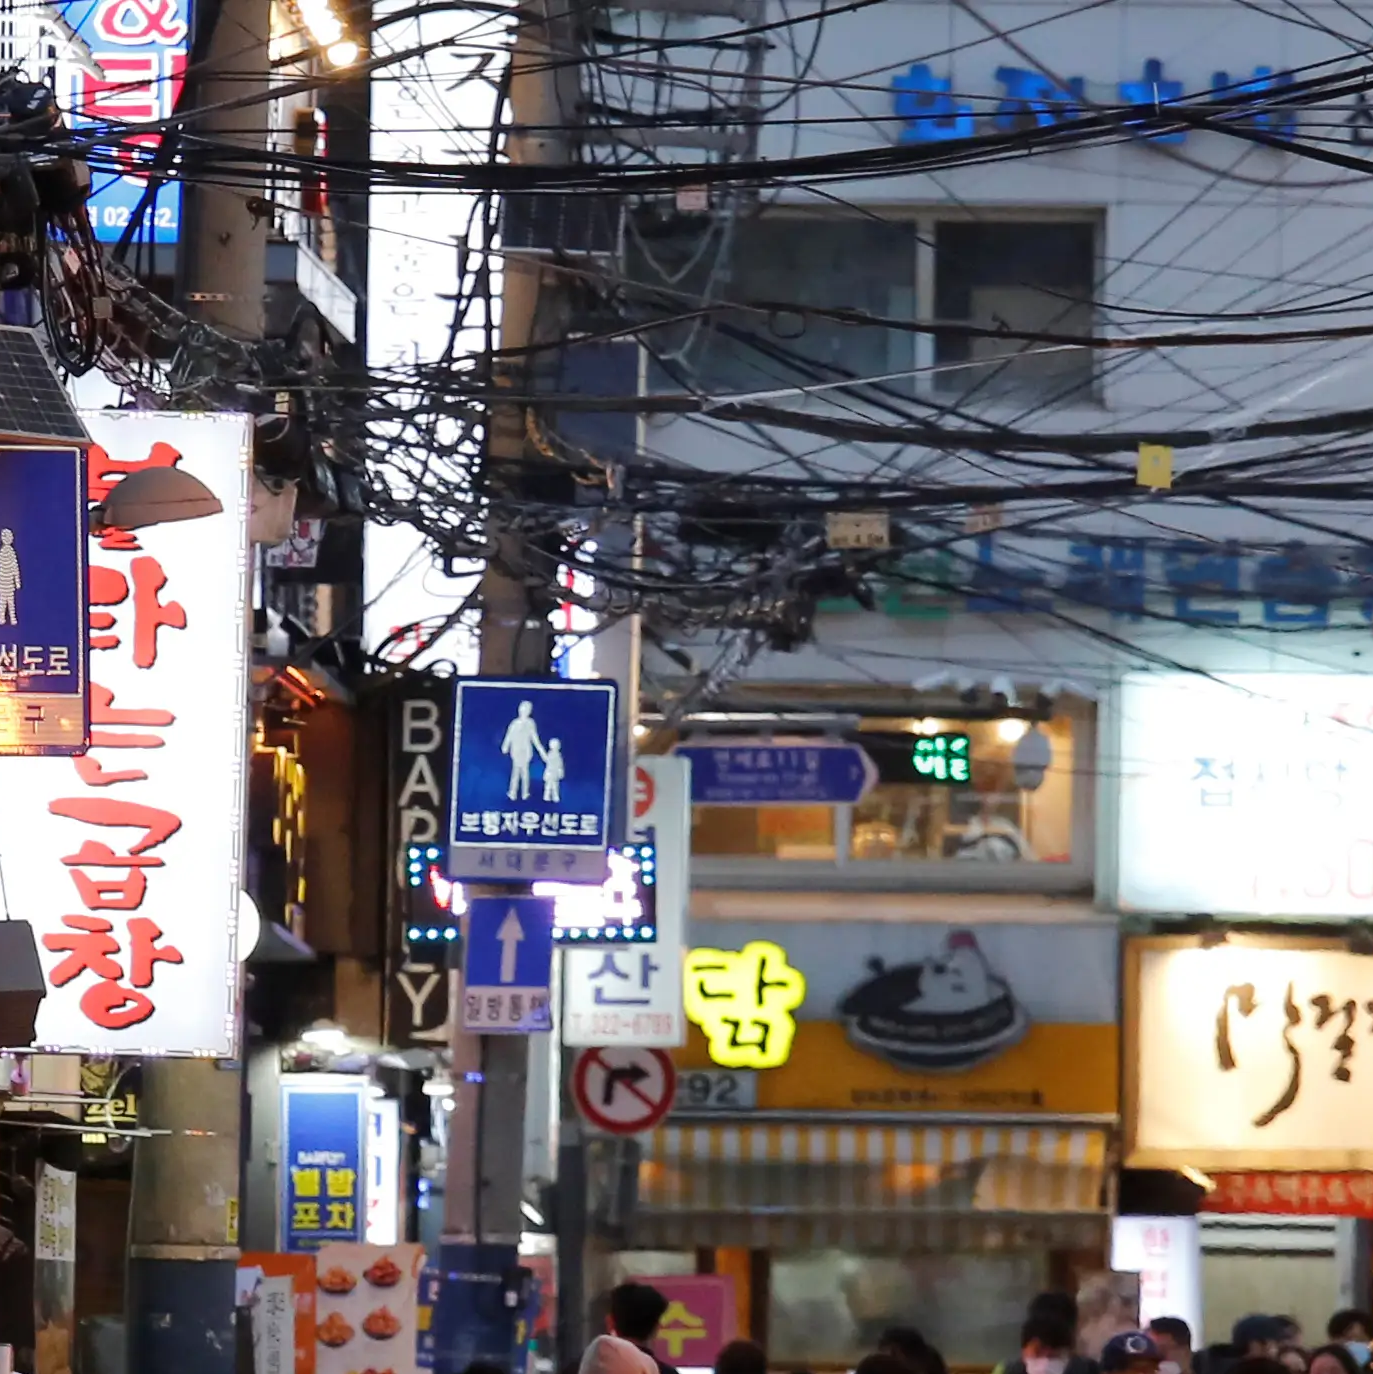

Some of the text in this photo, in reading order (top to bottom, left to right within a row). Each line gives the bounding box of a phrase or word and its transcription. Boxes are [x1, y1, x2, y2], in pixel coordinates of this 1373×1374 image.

[459, 810, 600, 837] 보행자우선도로
[477, 851, 579, 874] 서대문구
[587, 950, 661, 1006] 산
[465, 995, 549, 1024] 일방통행
